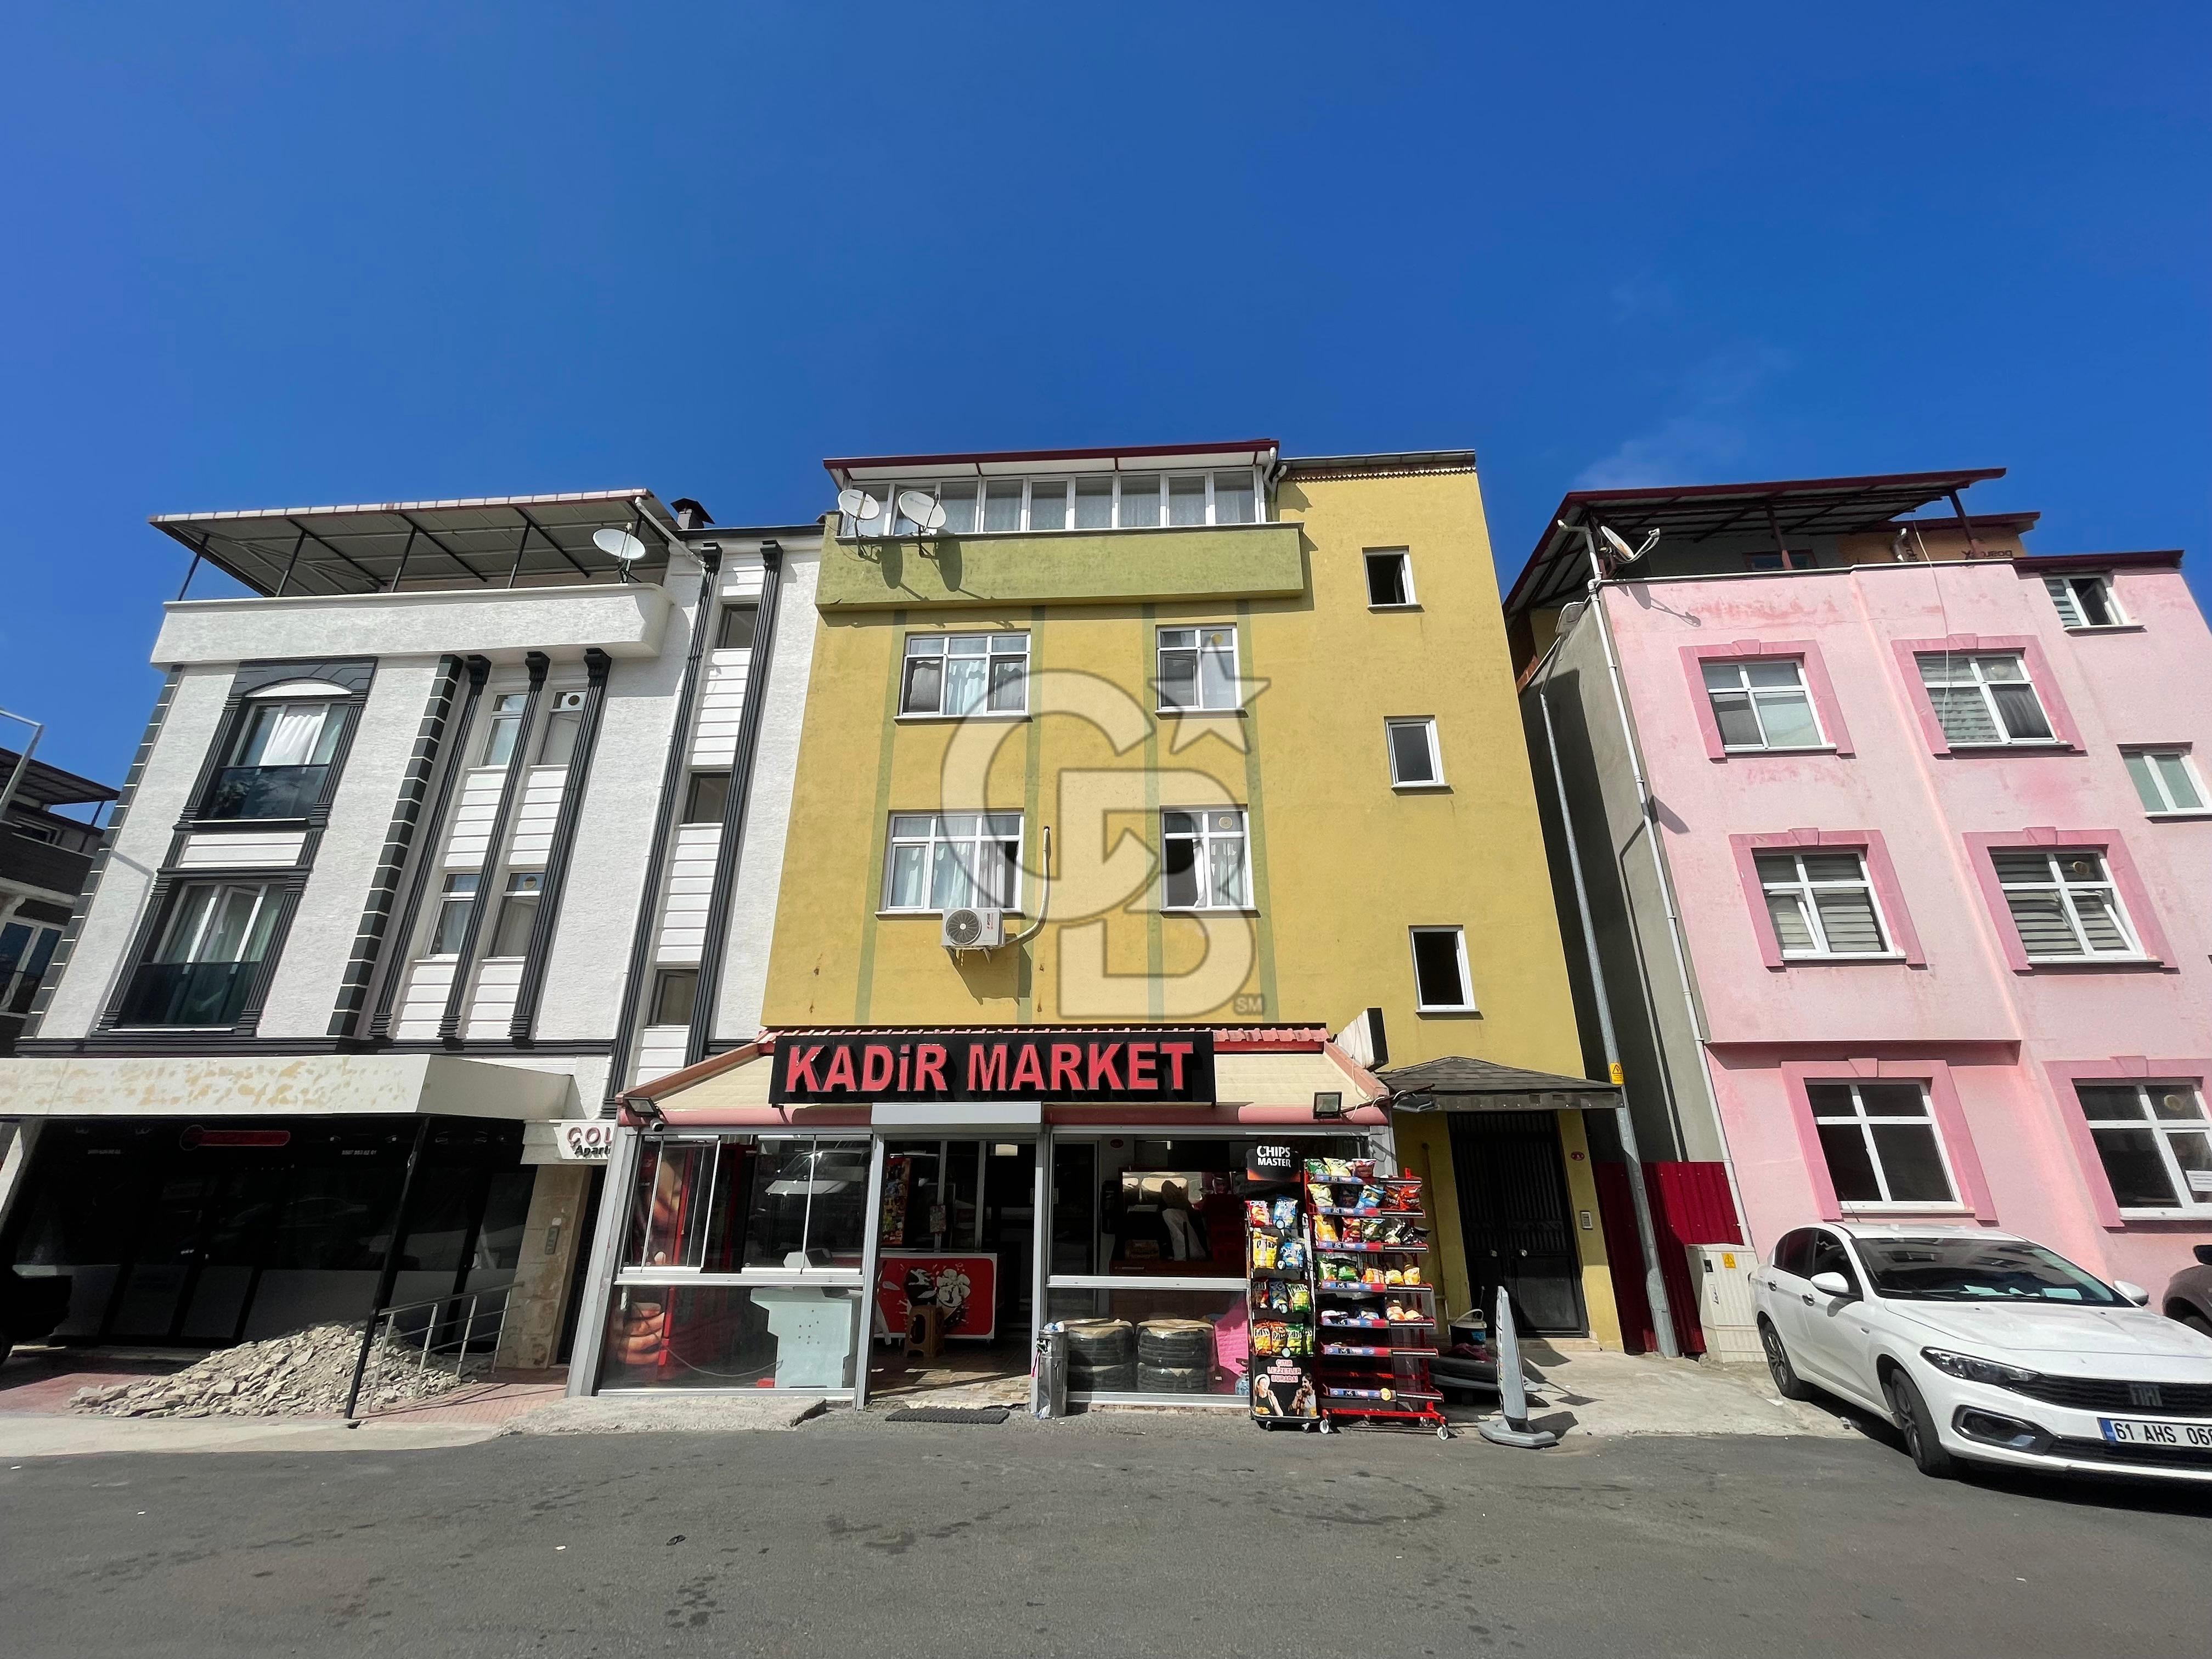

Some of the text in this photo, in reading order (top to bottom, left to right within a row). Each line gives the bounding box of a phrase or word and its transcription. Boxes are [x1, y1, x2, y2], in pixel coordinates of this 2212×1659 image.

[966, 1041, 1194, 1092] MARKET
[1256, 1146, 1291, 1158] CHIPS
[1257, 1157, 1291, 1168] MASTER
[2114, 1423, 2135, 1441] 61
[2143, 1425, 2177, 1443] AHS
